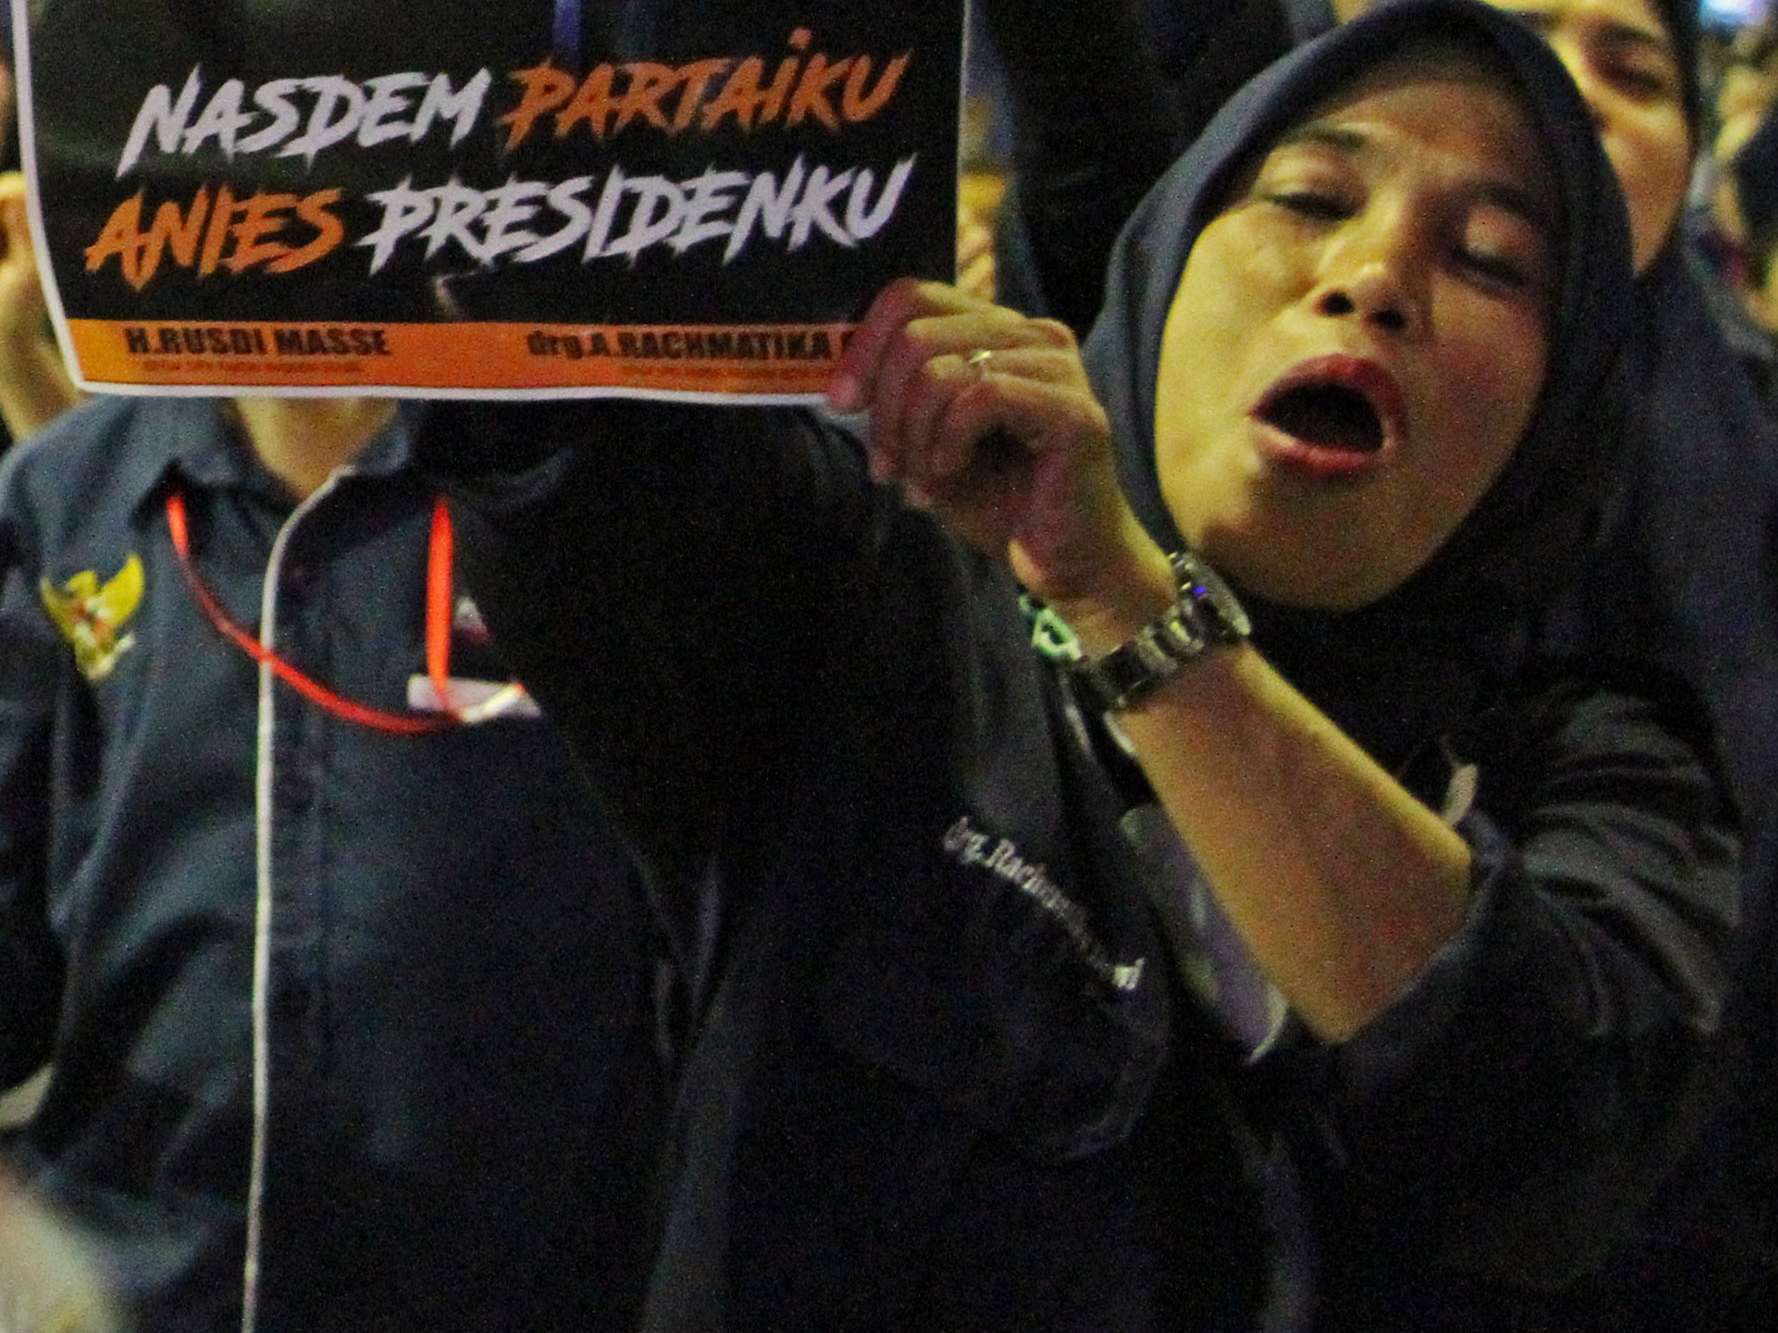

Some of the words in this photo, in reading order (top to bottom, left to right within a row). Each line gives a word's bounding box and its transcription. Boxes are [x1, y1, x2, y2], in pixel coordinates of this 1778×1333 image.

[114, 61, 494, 183] NASDEM
[83, 182, 346, 293] ANIES
[353, 151, 919, 278] PRESIDENKU
[273, 328, 392, 357] MASSE
